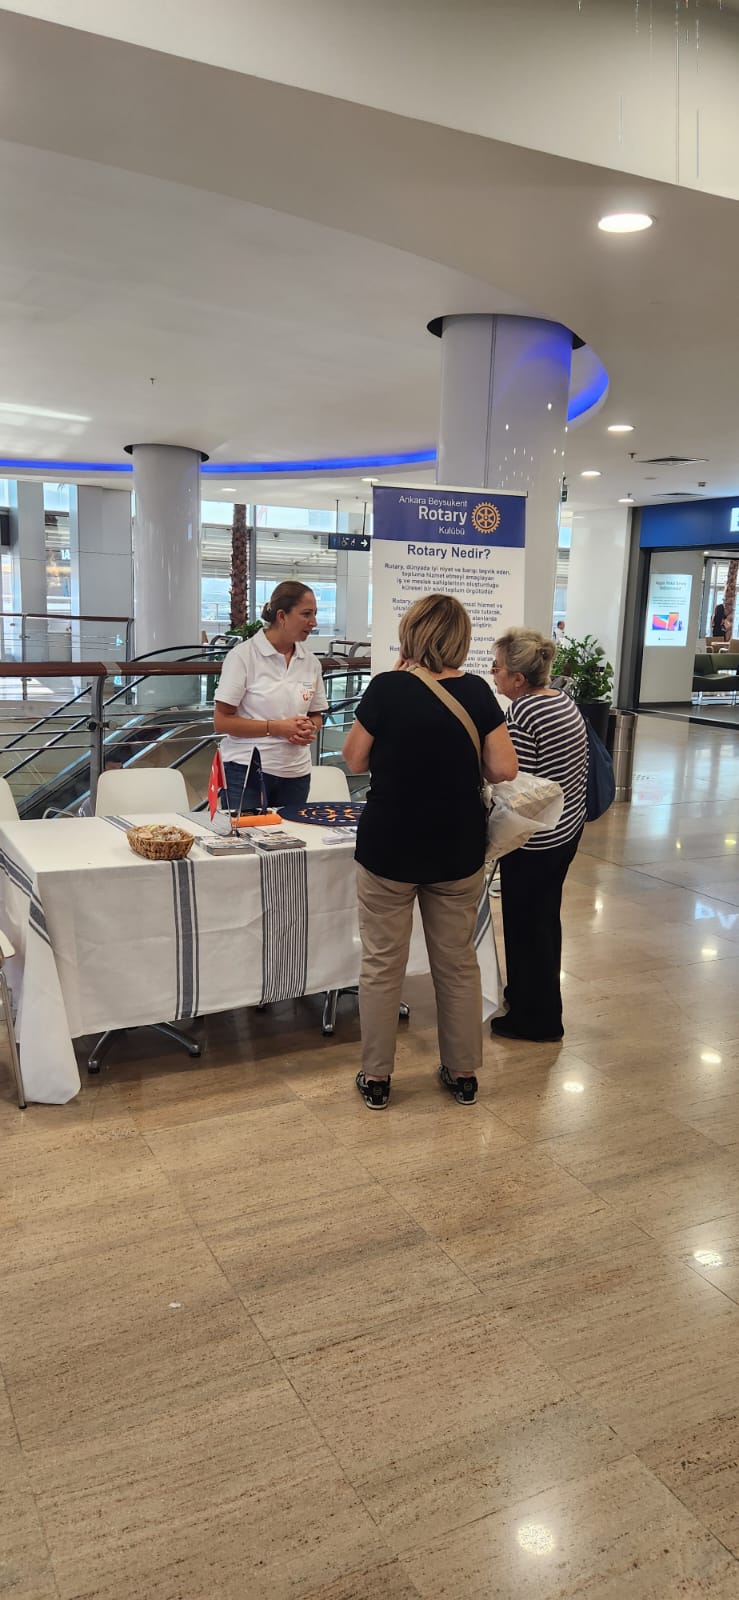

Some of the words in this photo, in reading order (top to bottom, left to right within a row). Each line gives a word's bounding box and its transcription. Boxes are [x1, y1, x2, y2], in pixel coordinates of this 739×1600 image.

[399, 495, 426, 505] Ankara
[429, 497, 468, 507] Beysukent
[418, 506, 468, 525] Rotary
[438, 526, 465, 535] Kulübü
[407, 544, 447, 559] Rotary
[452, 546, 491, 560] Nedir?
